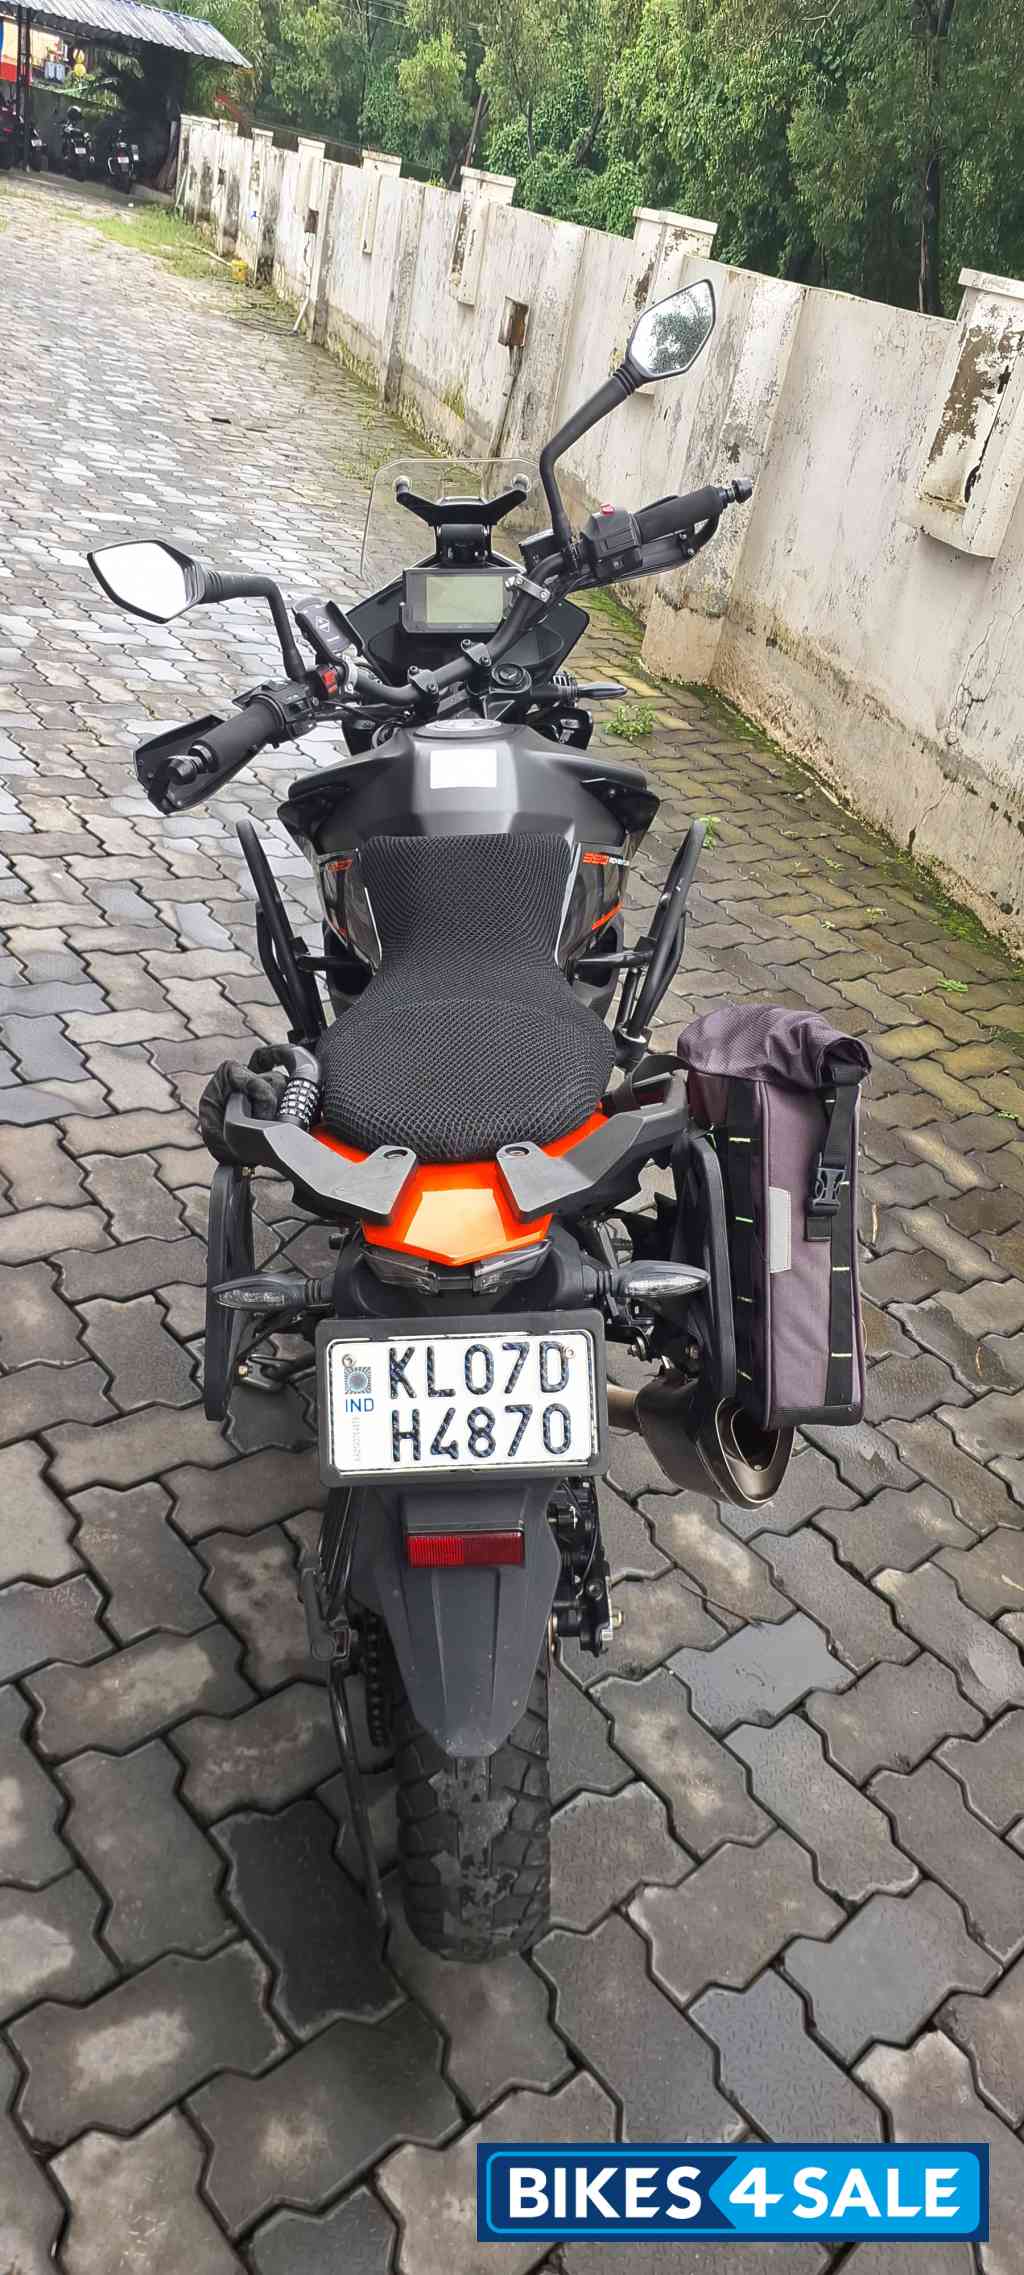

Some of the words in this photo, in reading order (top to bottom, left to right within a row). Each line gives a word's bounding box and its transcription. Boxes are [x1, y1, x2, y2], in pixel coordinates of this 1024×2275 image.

[389, 1341, 570, 1399] KL07D
[345, 1398, 374, 1412] IND
[392, 1403, 572, 1462] H4870
